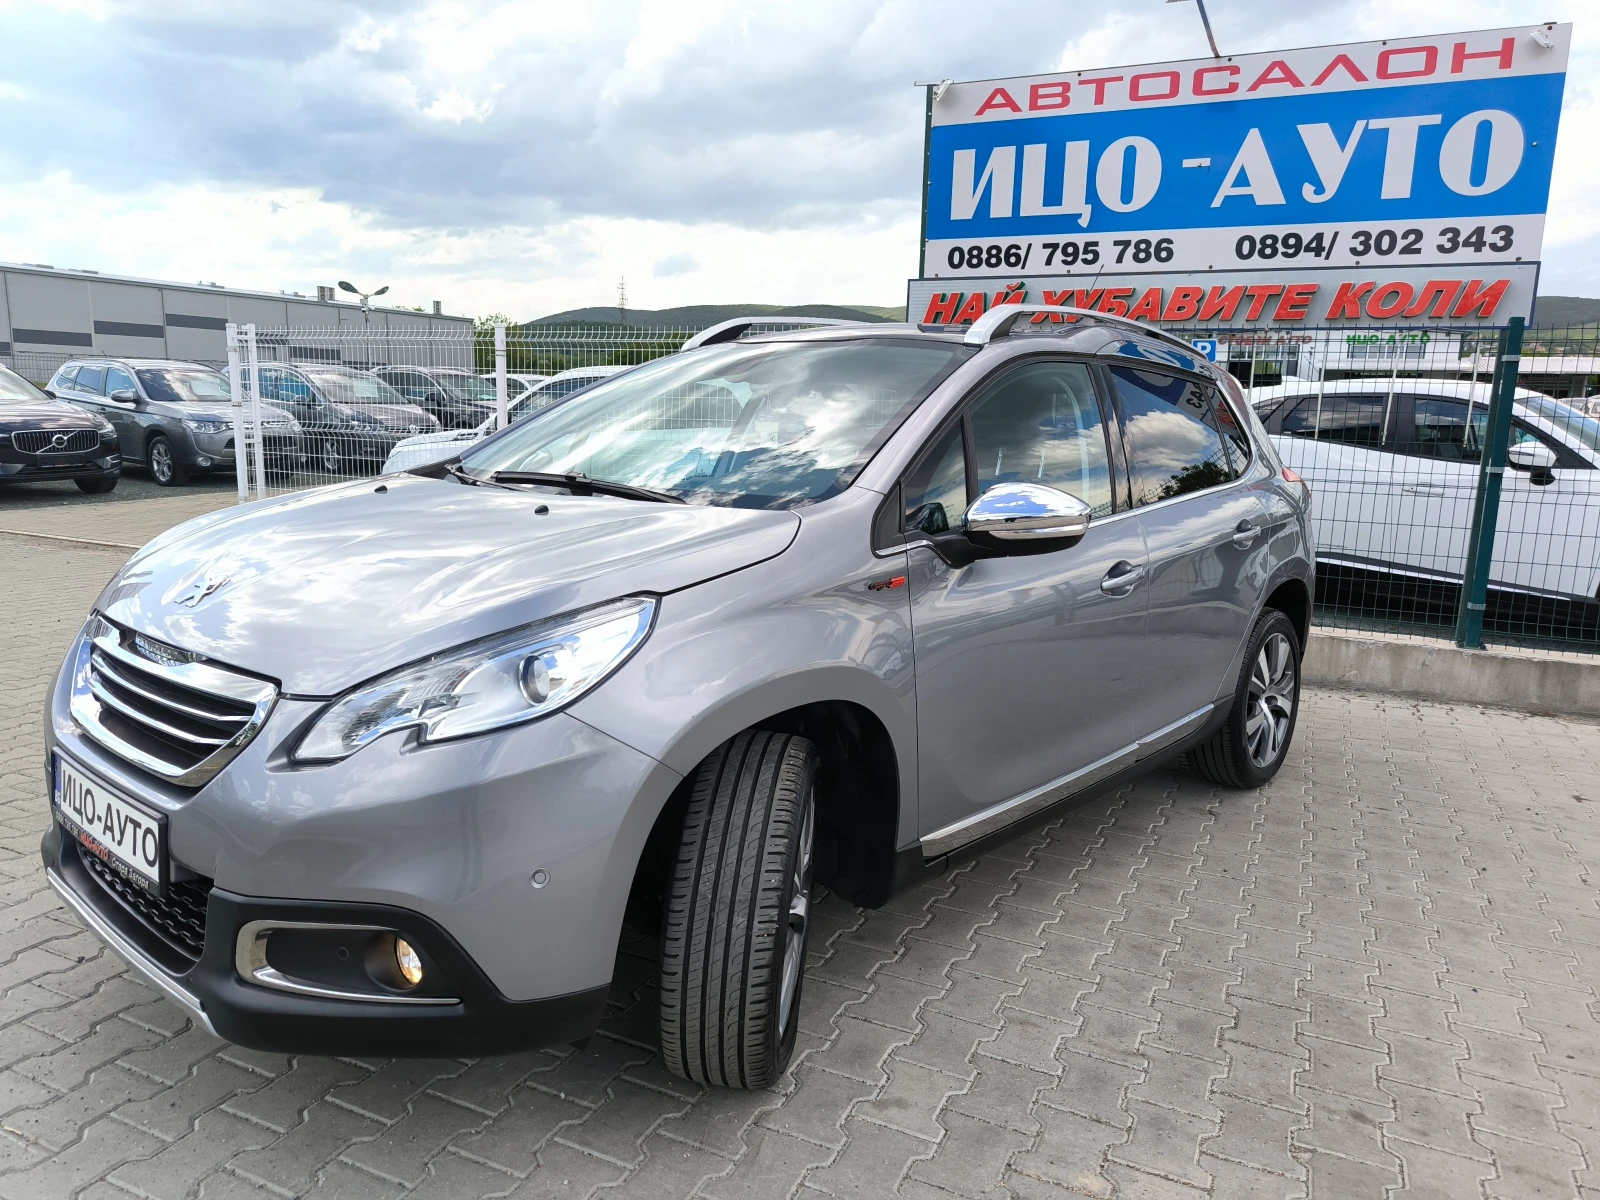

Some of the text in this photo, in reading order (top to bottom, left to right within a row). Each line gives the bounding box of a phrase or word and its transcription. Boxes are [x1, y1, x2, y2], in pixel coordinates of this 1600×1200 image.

[974, 37, 1515, 116] АВТОСАЛОН
[947, 225, 1514, 269] 0886/ 795 786 0894/ 302 343
[923, 279, 1511, 325] НАЙ ХУБАВИТЕ КОЛИ
[63, 769, 158, 868] ИЦО-АУТО
